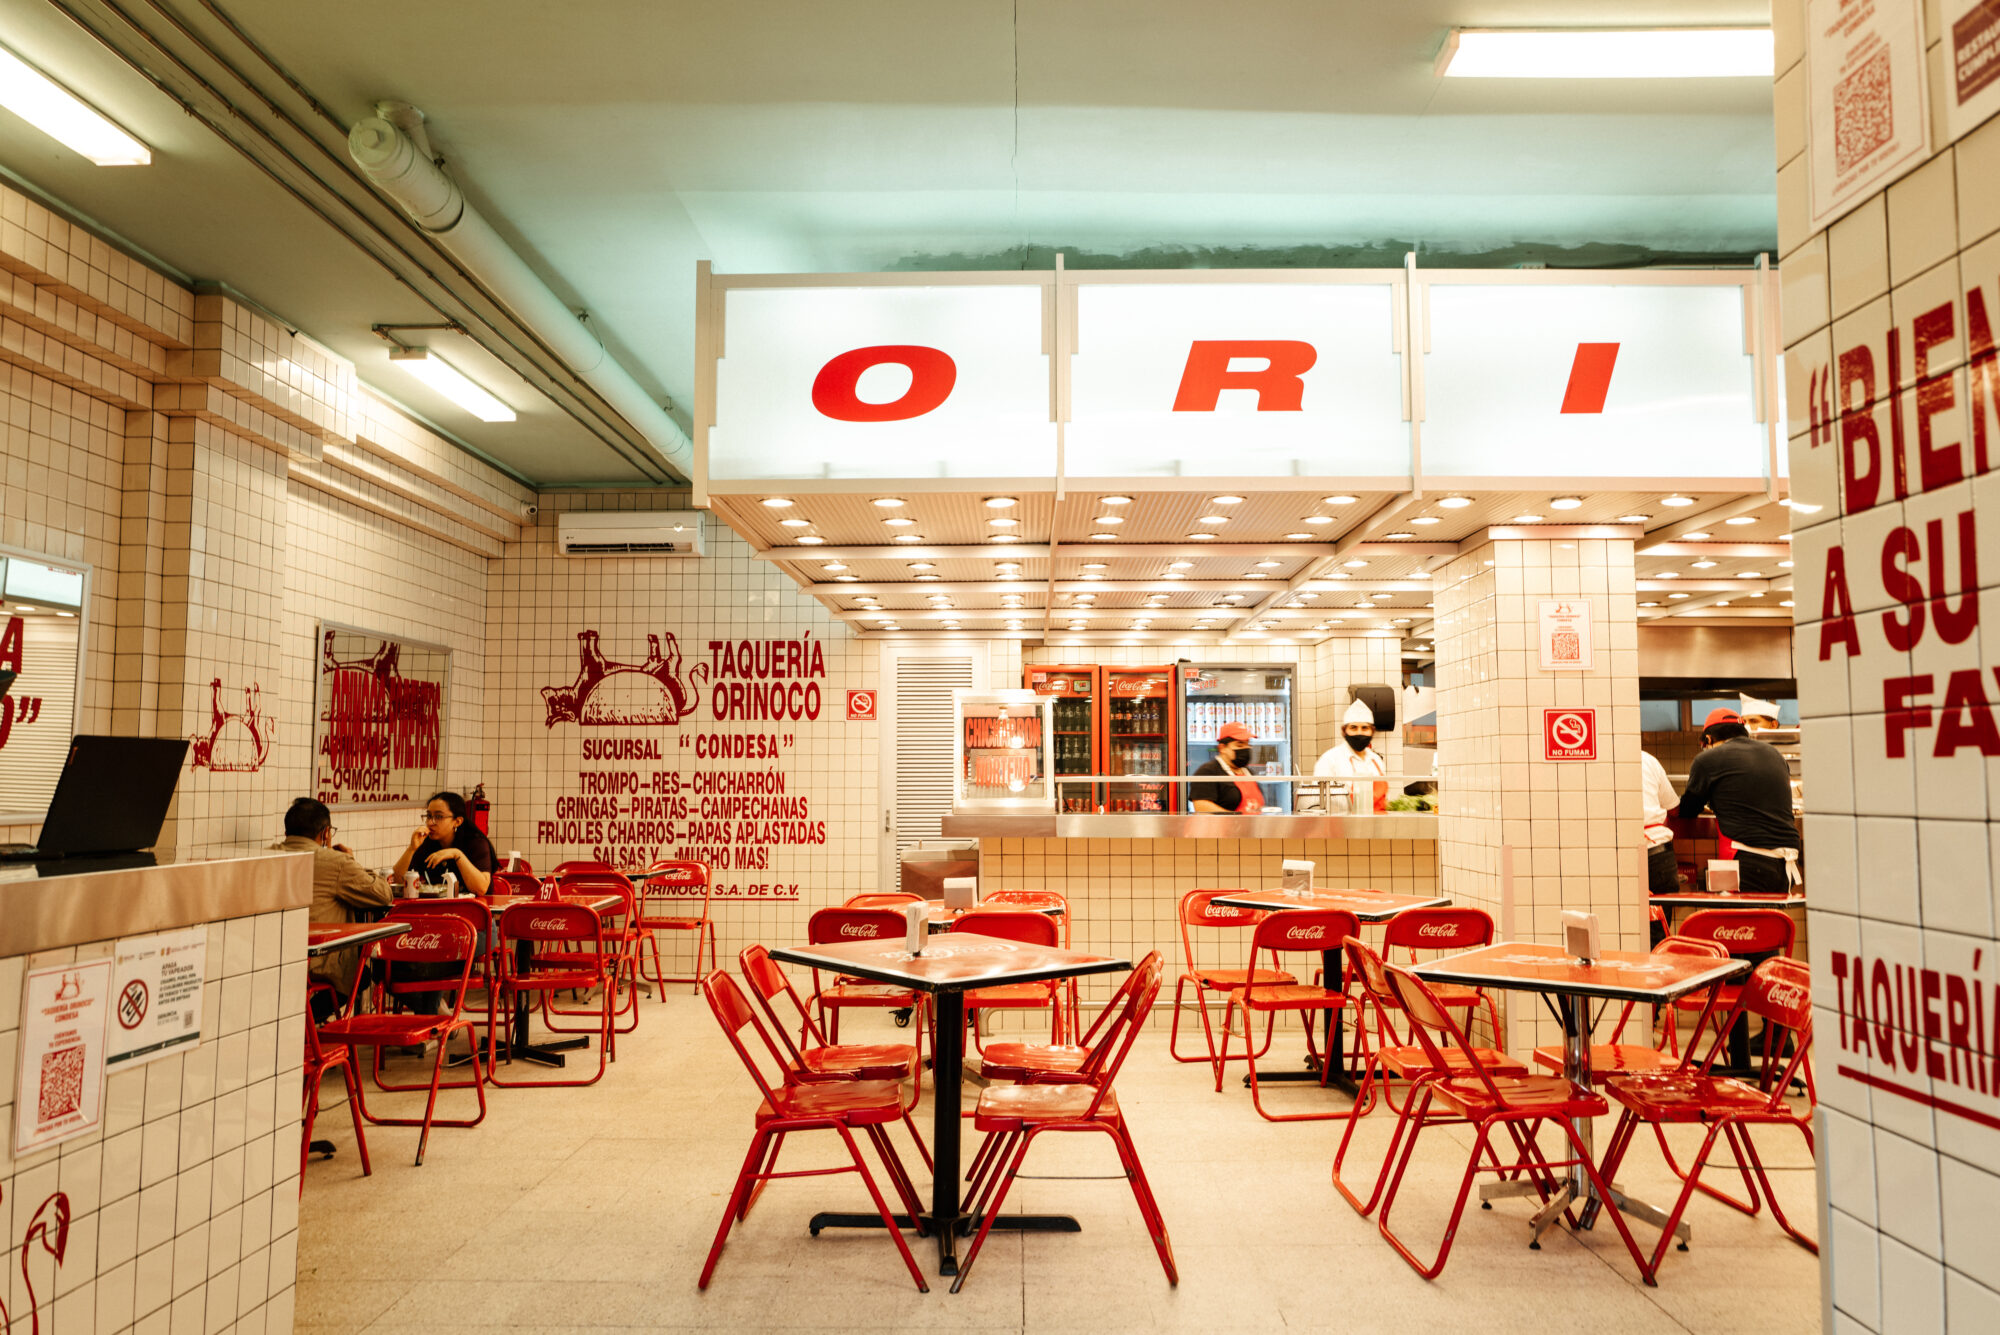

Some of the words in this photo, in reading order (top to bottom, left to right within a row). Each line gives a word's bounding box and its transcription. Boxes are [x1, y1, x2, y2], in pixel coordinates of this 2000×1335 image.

[1819, 545, 1861, 662] A
[1881, 508, 1980, 652] SU
[709, 630, 826, 680] TAQUERÍA
[712, 681, 821, 721] ORINOCO
[1883, 666, 2000, 758] FA
[583, 739, 662, 761] SUCURSAL
[538, 821, 603, 845] FRIJOLES
[735, 821, 826, 845] APLASTADAS
[593, 847, 646, 870] SALSAS
[650, 847, 660, 864] Y
[674, 847, 731, 870] MUCHO
[734, 840, 769, 870] MÁS!
[540, 883, 555, 900] 157
[641, 884, 709, 896] ORINOCO
[714, 884, 743, 896] S.A.
[747, 884, 768, 896] DE
[773, 884, 799, 896] C.V.
[1205, 904, 1240, 918] Coca-Cola
[530, 917, 567, 931] Coca-Cola
[840, 923, 878, 938] Coca-Cola
[1286, 925, 1325, 940] Coca-Cola
[1418, 923, 1459, 938] Coca-Cola
[396, 933, 441, 950] Coca-Cola
[1713, 925, 1755, 941] Coca-Cola
